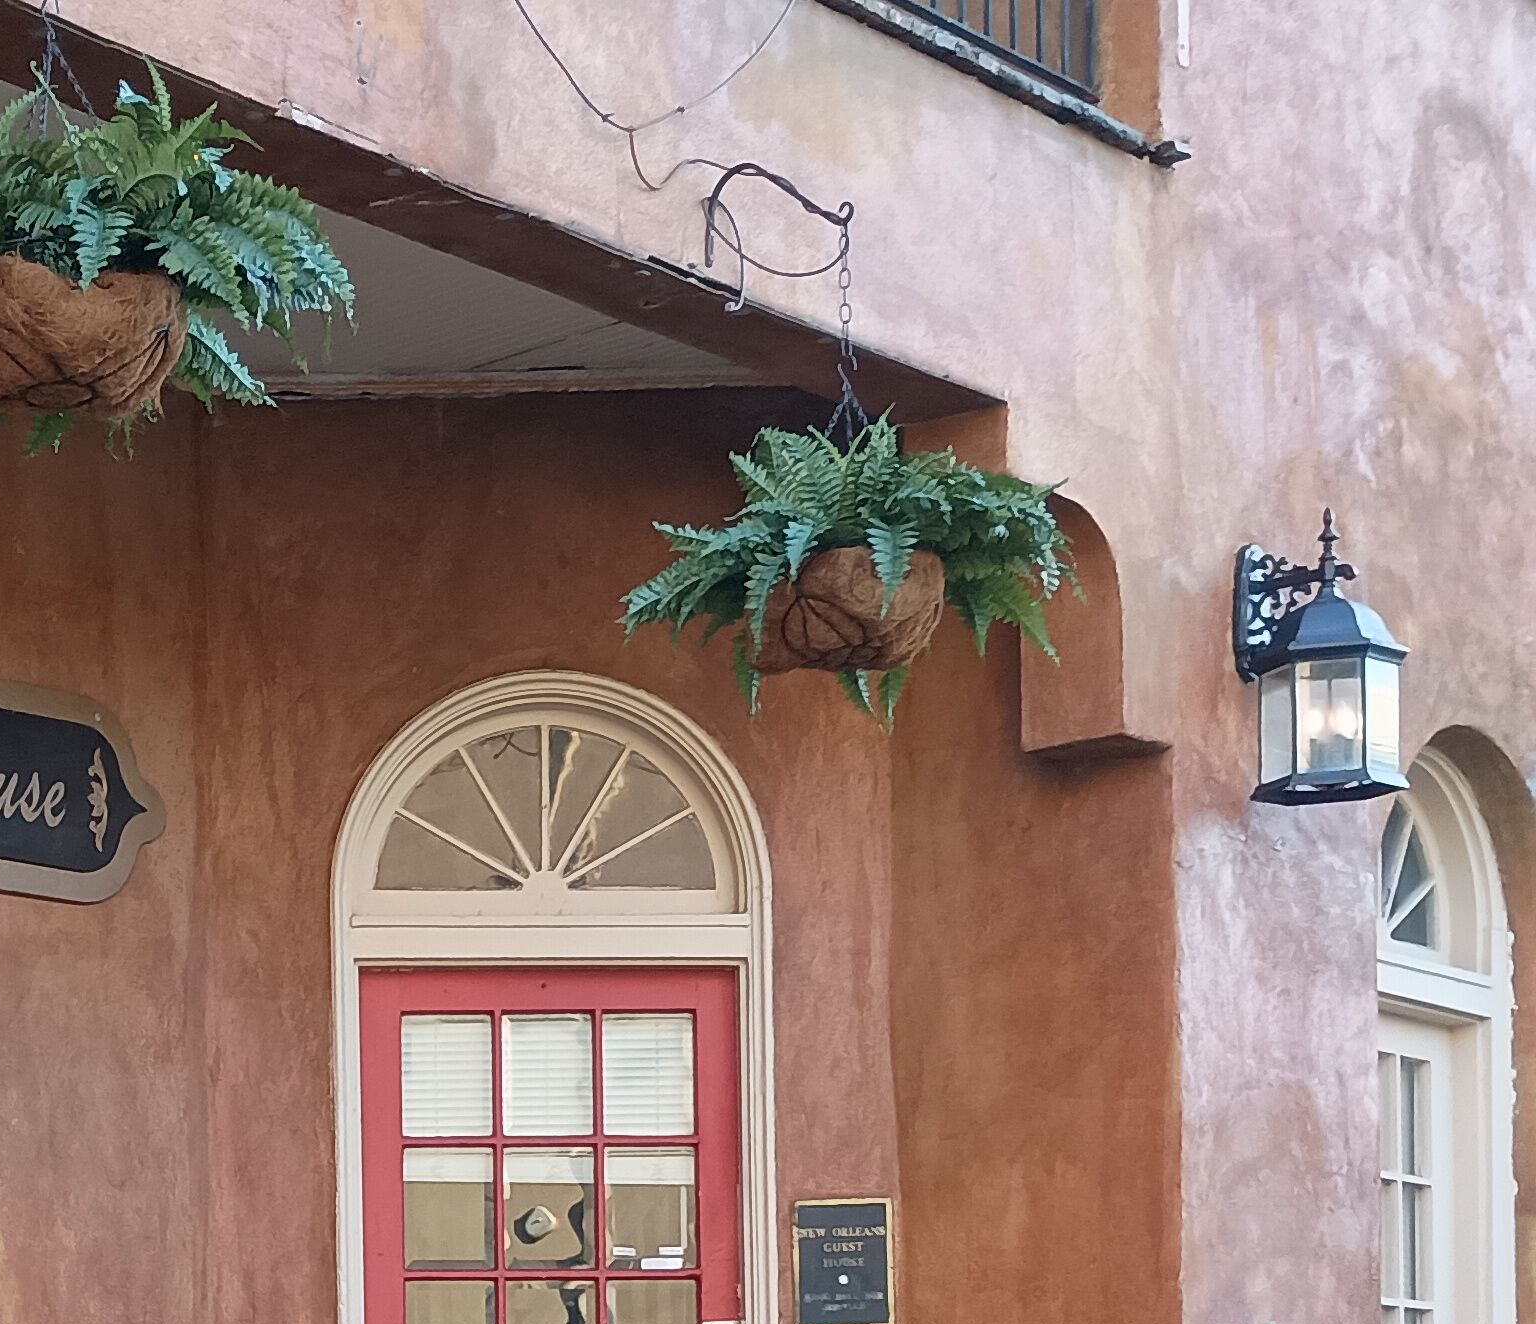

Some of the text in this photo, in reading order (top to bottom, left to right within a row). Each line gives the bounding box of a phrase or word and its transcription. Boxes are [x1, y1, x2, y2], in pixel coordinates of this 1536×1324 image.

[798, 1226, 886, 1238] NEW ORLEANS
[823, 1241, 864, 1252] GUEST
[822, 1257, 864, 1268] HOUSE
